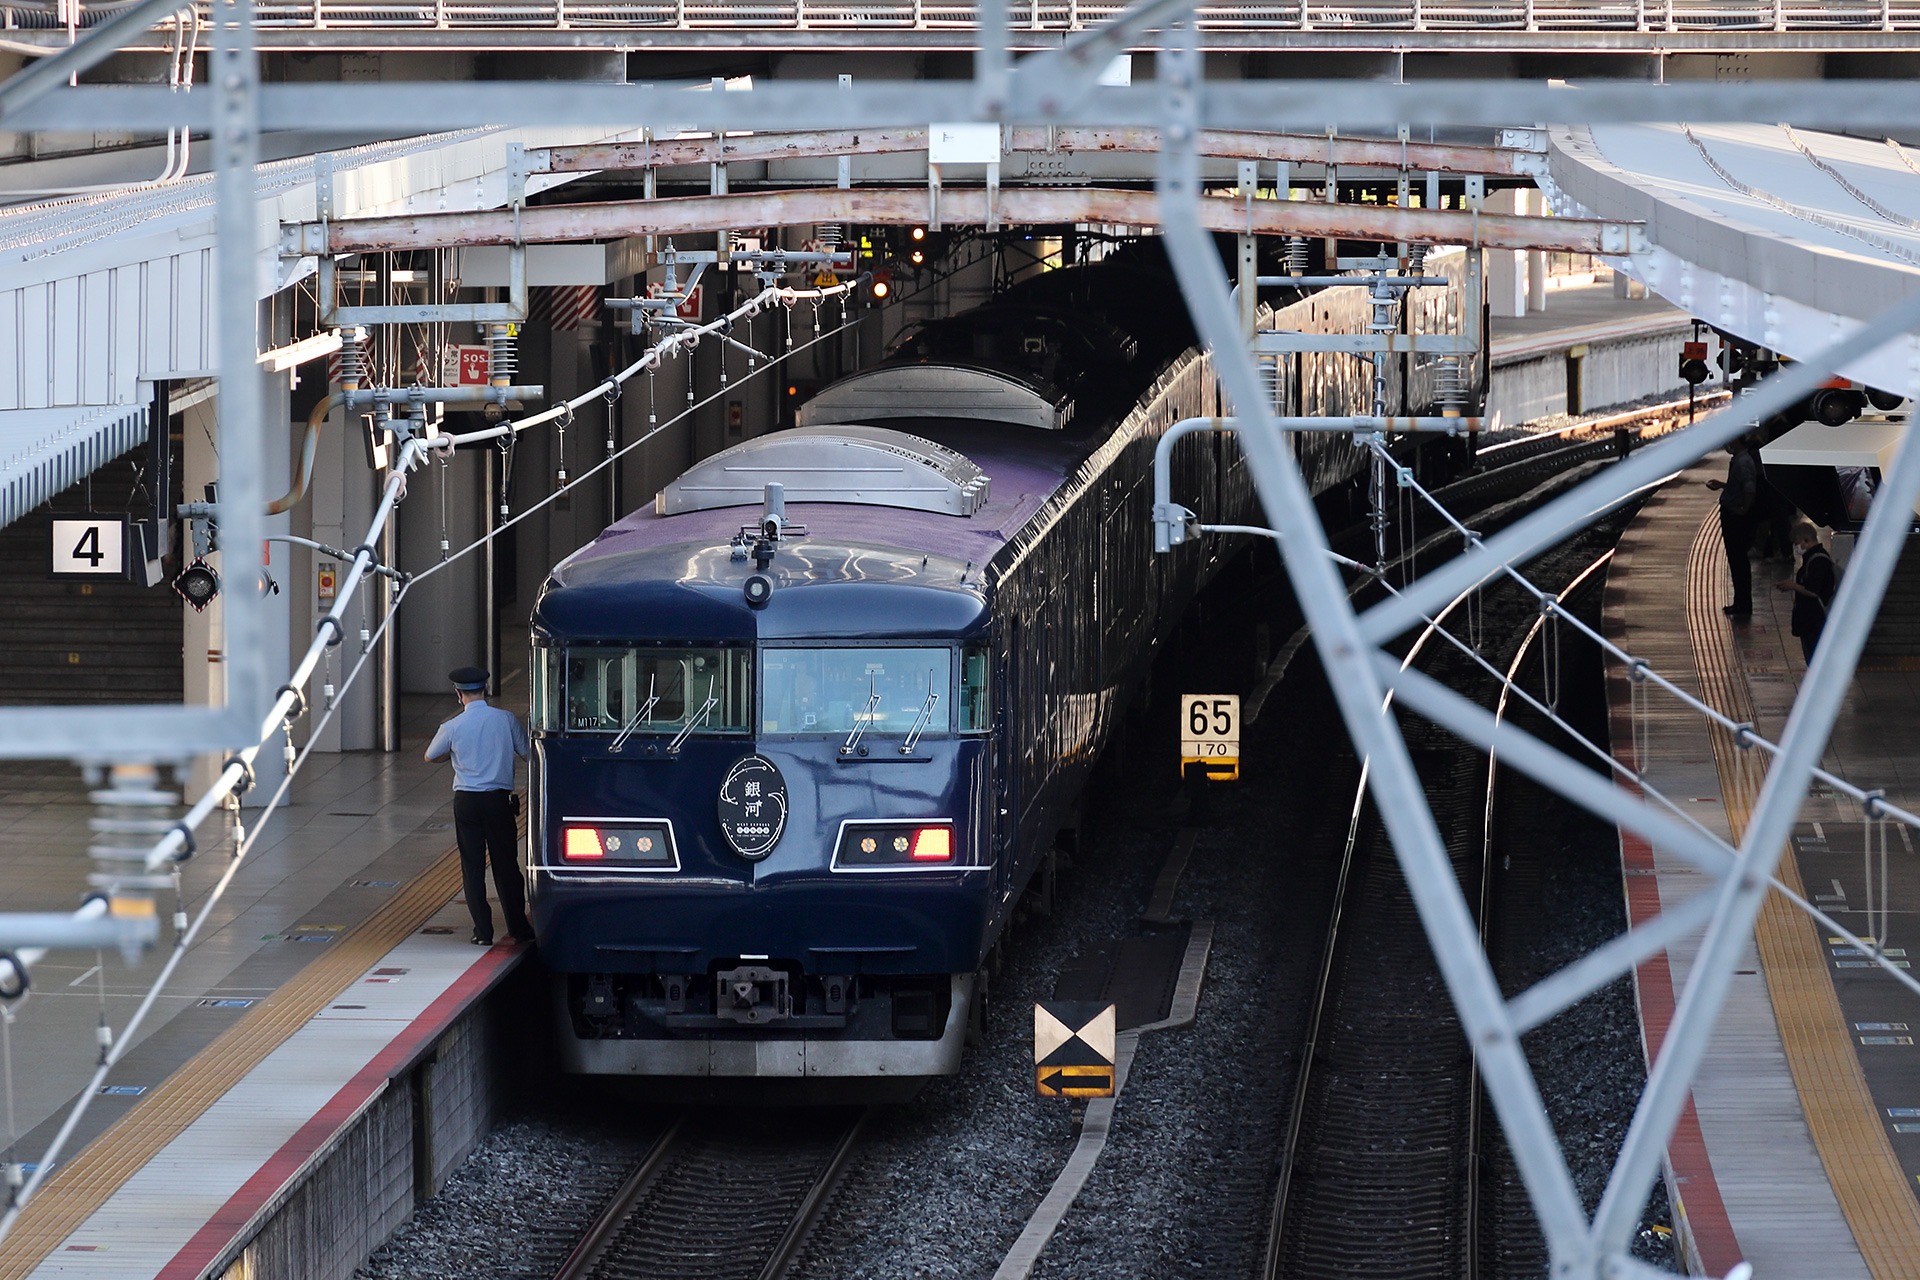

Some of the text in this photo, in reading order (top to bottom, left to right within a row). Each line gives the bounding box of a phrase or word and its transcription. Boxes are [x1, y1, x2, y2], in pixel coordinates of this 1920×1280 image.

[463, 353, 486, 363] SOS
[72, 526, 104, 567] 4
[578, 717, 597, 727] M117
[1190, 700, 1231, 735] 65
[1197, 743, 1227, 756] 170
[744, 780, 762, 818] 銀河
